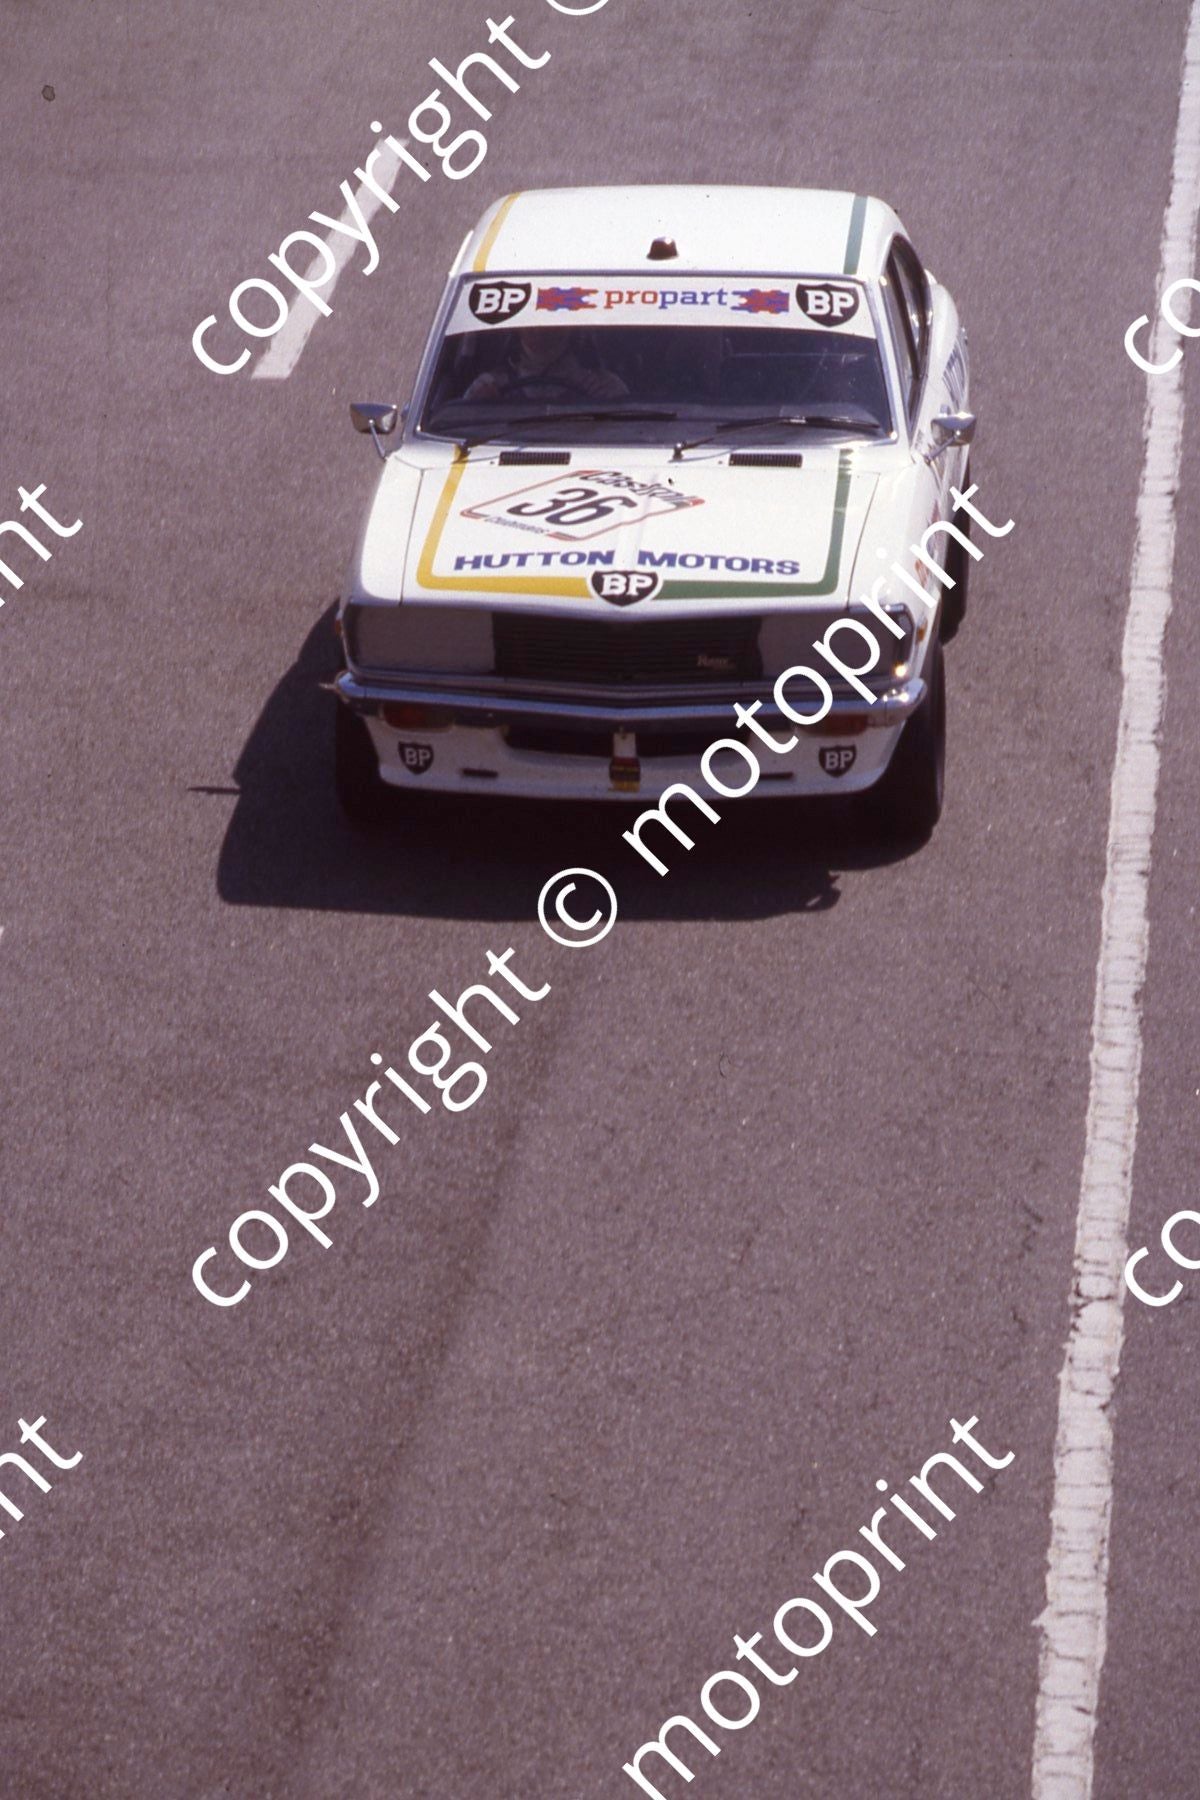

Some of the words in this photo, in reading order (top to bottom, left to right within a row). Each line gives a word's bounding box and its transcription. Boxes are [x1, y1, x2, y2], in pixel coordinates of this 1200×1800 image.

[474, 287, 524, 314] BP
[603, 287, 729, 310] propart
[804, 290, 856, 318] BP
[506, 487, 638, 527] 36
[454, 549, 616, 571] HUTTON
[637, 550, 801, 576] MOTORS
[601, 573, 654, 597] BP
[405, 746, 432, 769] BP
[824, 749, 855, 772] BP
